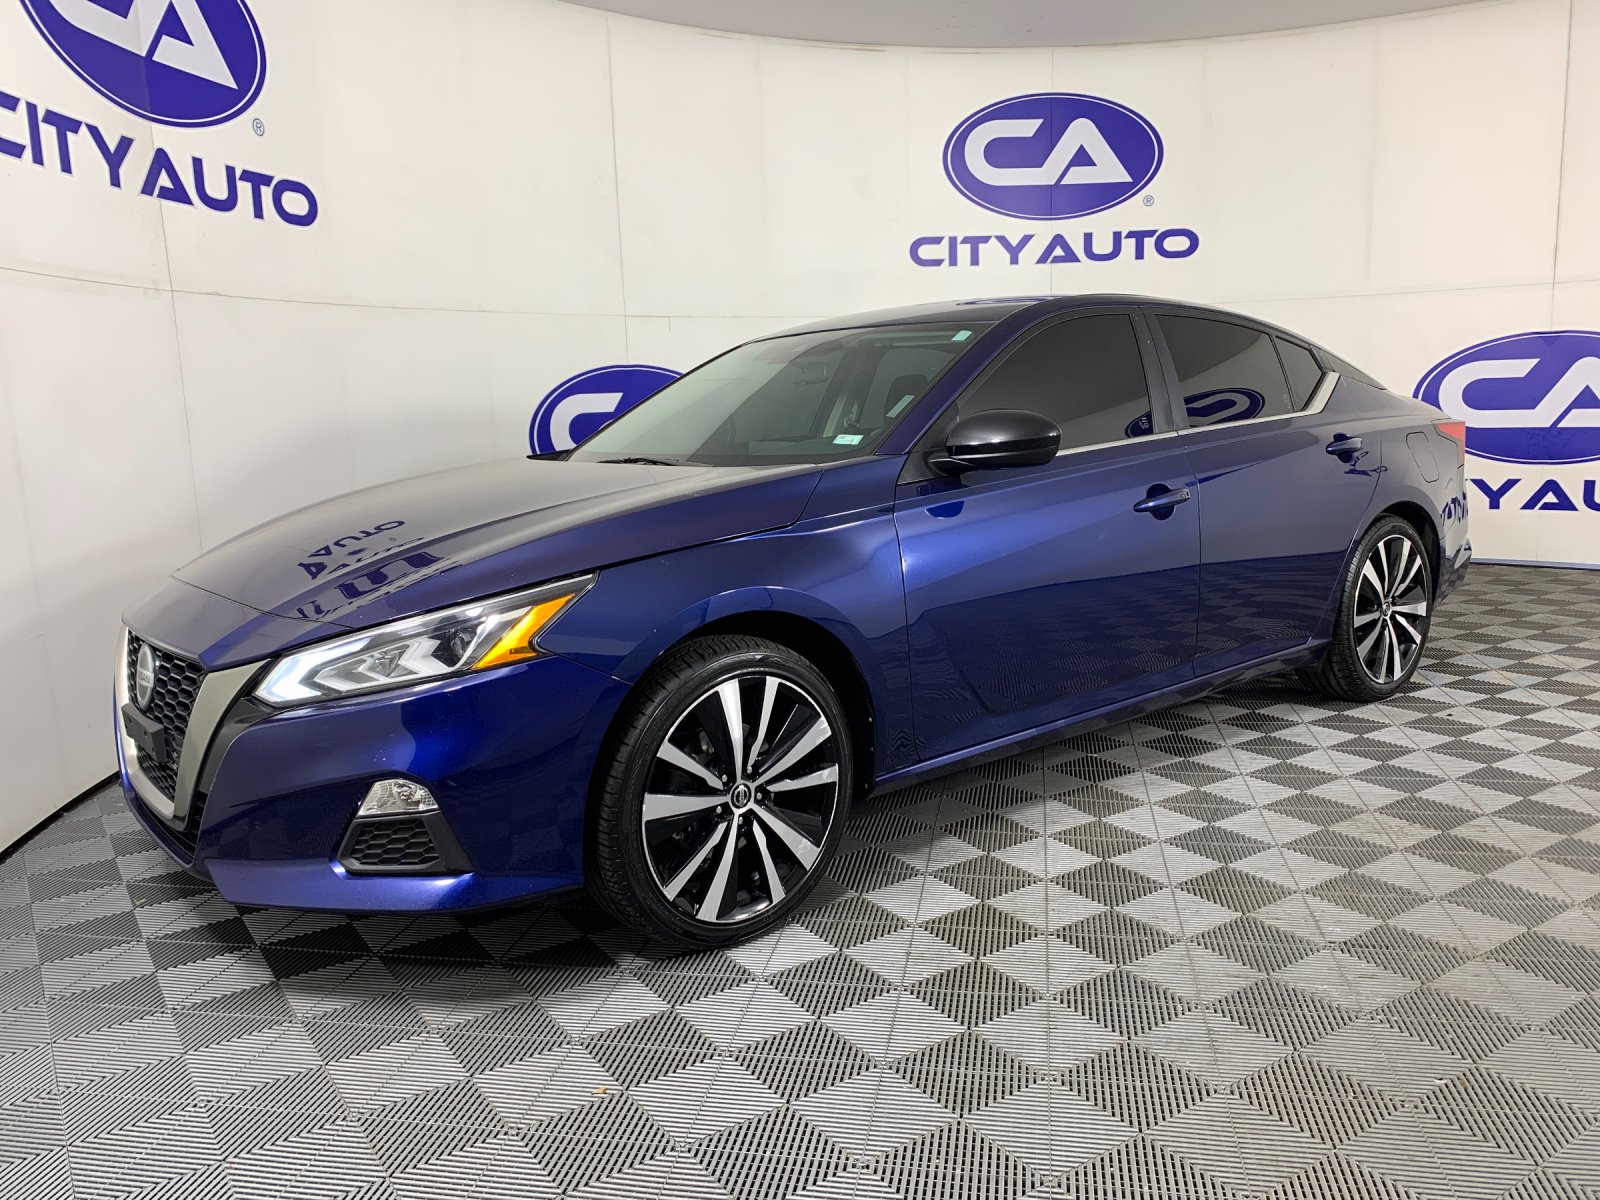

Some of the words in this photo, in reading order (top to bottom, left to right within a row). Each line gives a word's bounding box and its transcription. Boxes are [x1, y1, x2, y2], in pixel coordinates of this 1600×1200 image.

[139, 147, 318, 227] AUTO
[964, 117, 1134, 187] CA
[909, 234, 1036, 267] CITY
[1034, 228, 1200, 265] AUTO
